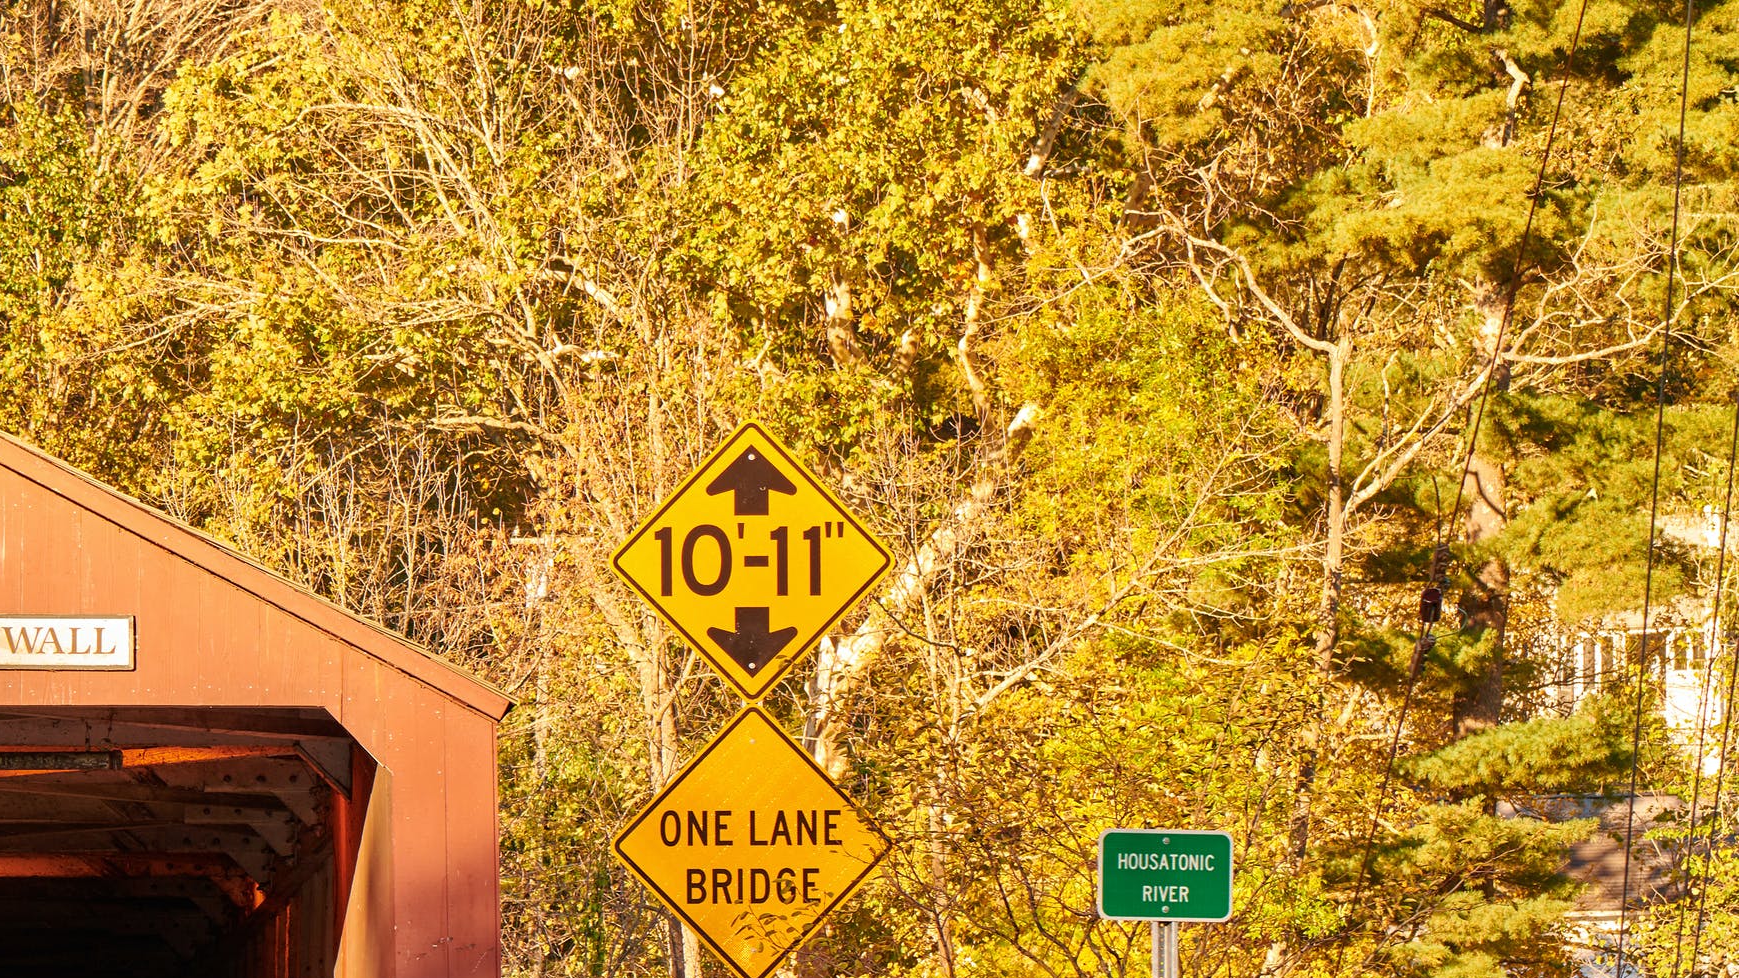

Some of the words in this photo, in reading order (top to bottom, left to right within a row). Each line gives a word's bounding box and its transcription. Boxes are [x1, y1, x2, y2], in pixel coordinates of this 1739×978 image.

[654, 522, 844, 597] 10'-11"
[660, 810, 734, 847] ONE
[749, 809, 843, 846] LANE
[1117, 853, 1215, 872] HOUSATONIC
[686, 867, 822, 905] BRIDGE
[1142, 885, 1190, 903] RIVER
